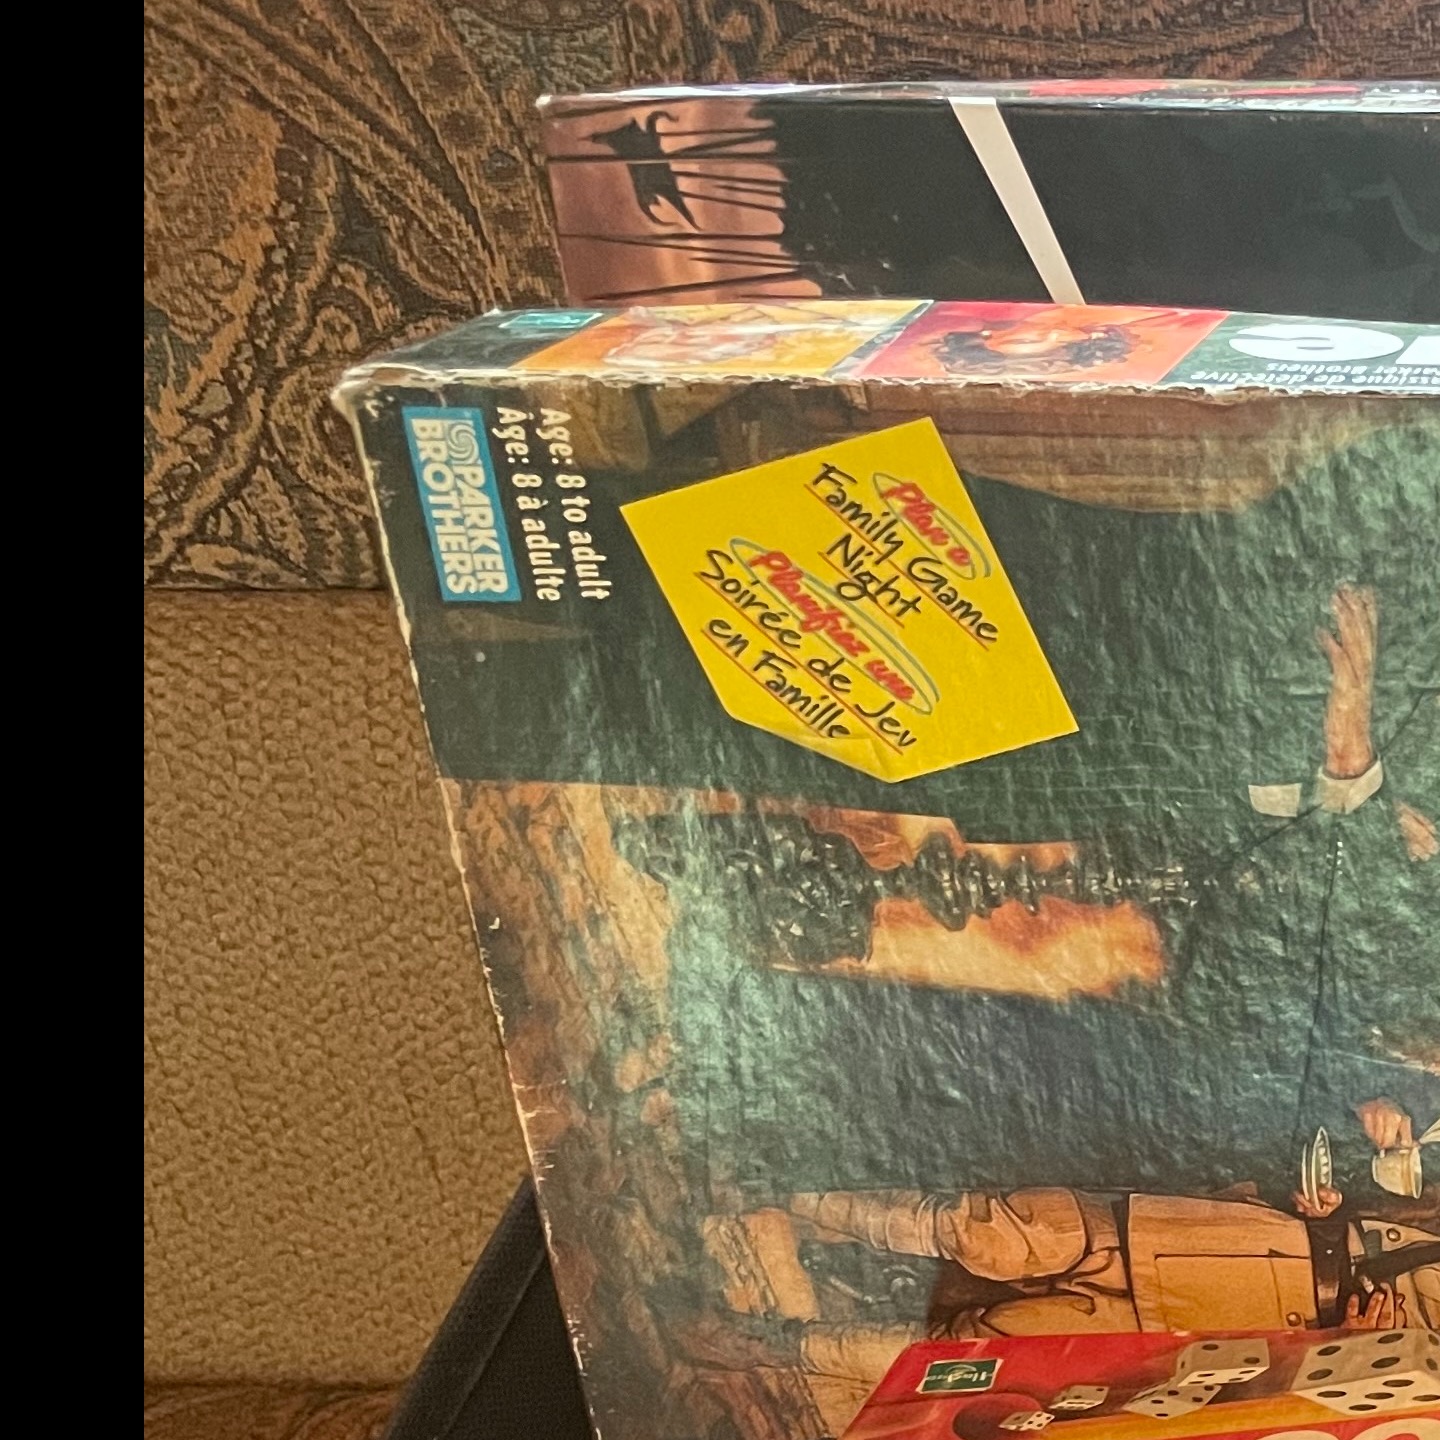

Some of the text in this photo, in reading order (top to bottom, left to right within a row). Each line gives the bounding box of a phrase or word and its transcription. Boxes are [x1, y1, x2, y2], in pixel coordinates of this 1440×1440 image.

[411, 418, 476, 594] BROTHERS
[452, 464, 509, 594] PARKER
[511, 473, 566, 600] 8 adulte
[536, 407, 613, 600] Age: 8 to adult
[812, 462, 999, 642] Family Game
[826, 533, 922, 617] Night
[753, 650, 850, 738] Famille
